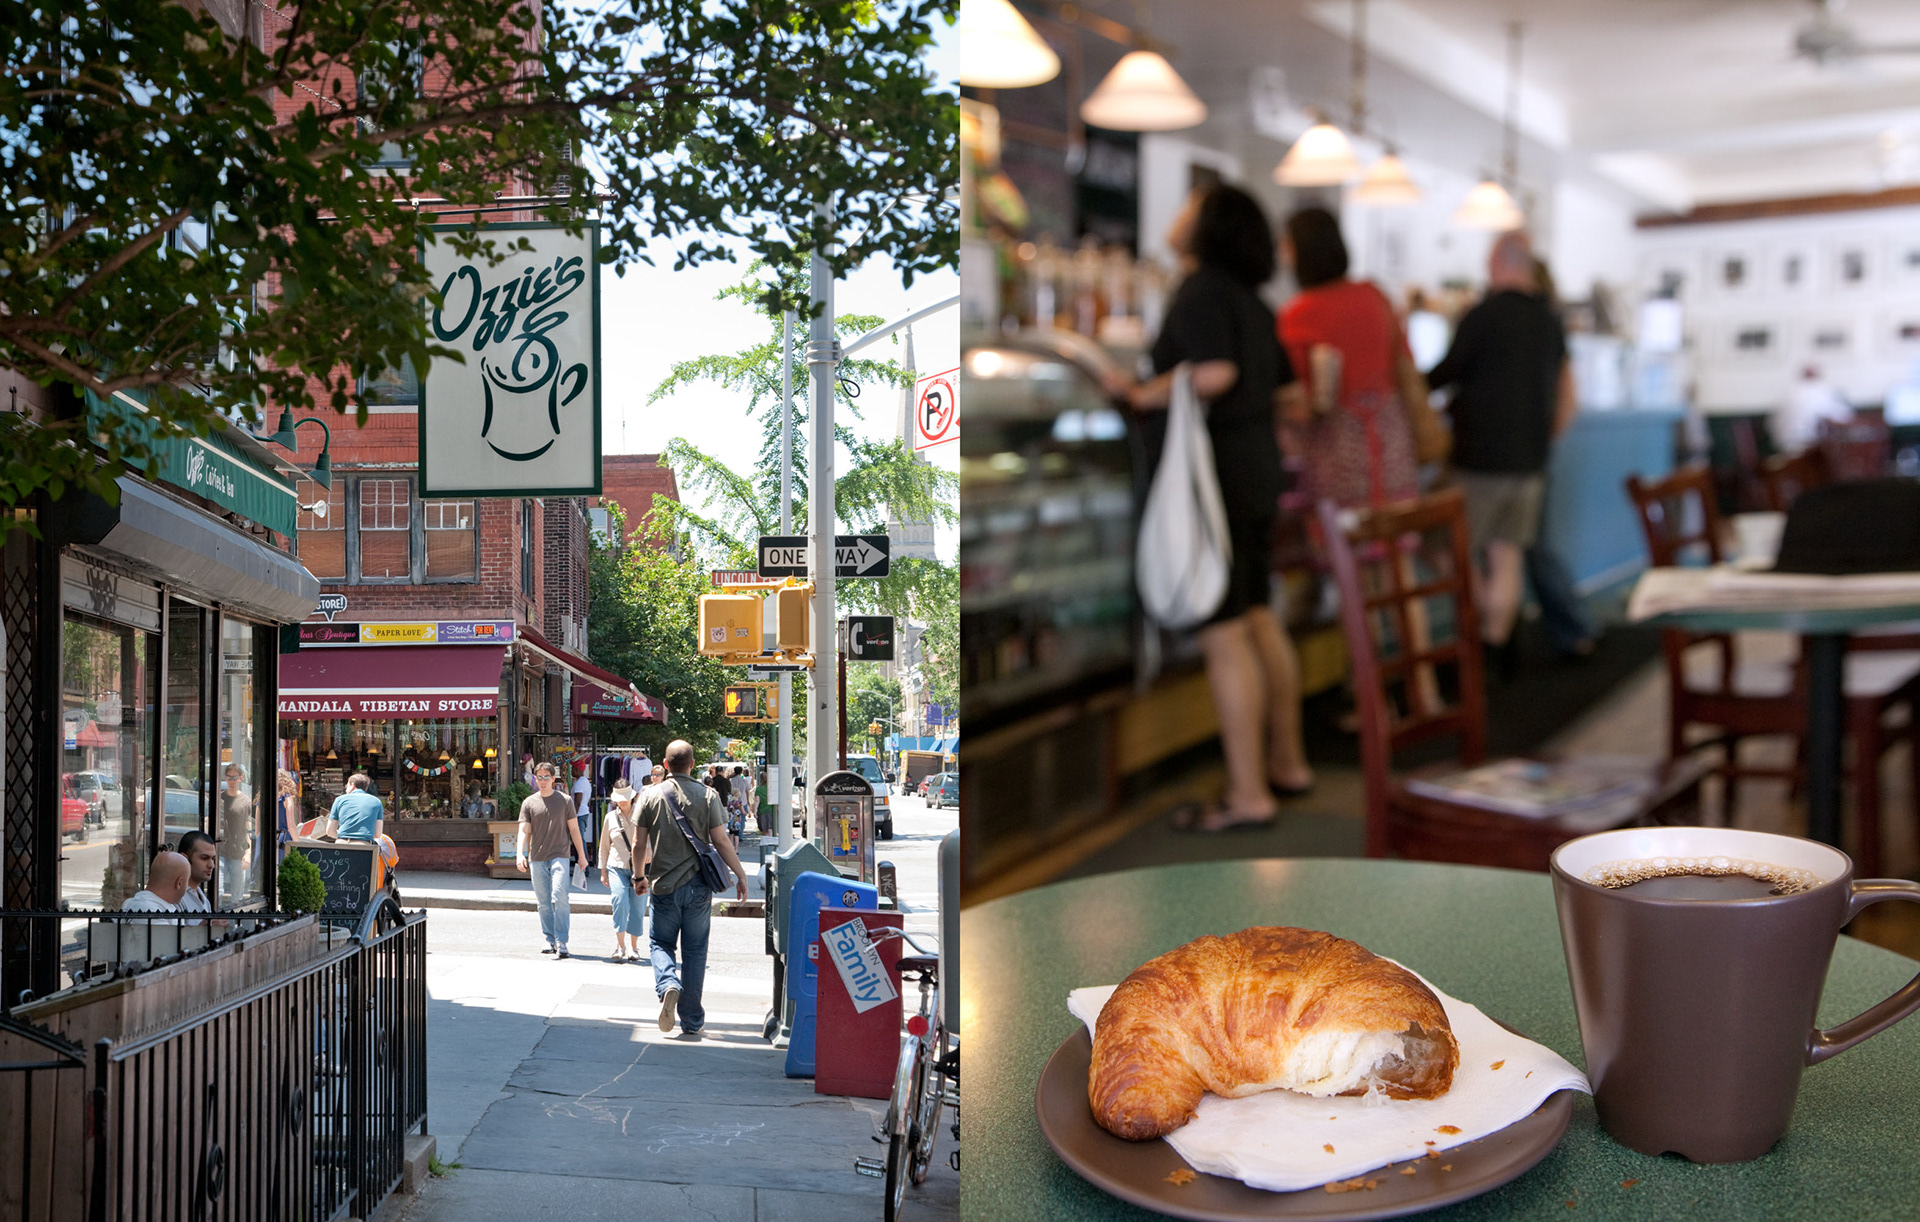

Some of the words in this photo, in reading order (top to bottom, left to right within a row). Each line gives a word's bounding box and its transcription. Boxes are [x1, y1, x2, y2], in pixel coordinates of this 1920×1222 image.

[432, 256, 585, 351] Ozzie's
[769, 549, 806, 565] ONE
[715, 572, 757, 585] LINCOLN
[315, 626, 356, 641] Boutique
[376, 629, 400, 637] PAPER
[402, 629, 421, 637] LOVE
[446, 624, 472, 635] Stitch
[360, 700, 431, 712] TIBETAN
[438, 699, 493, 711] STORE
[831, 923, 882, 1002] Family
